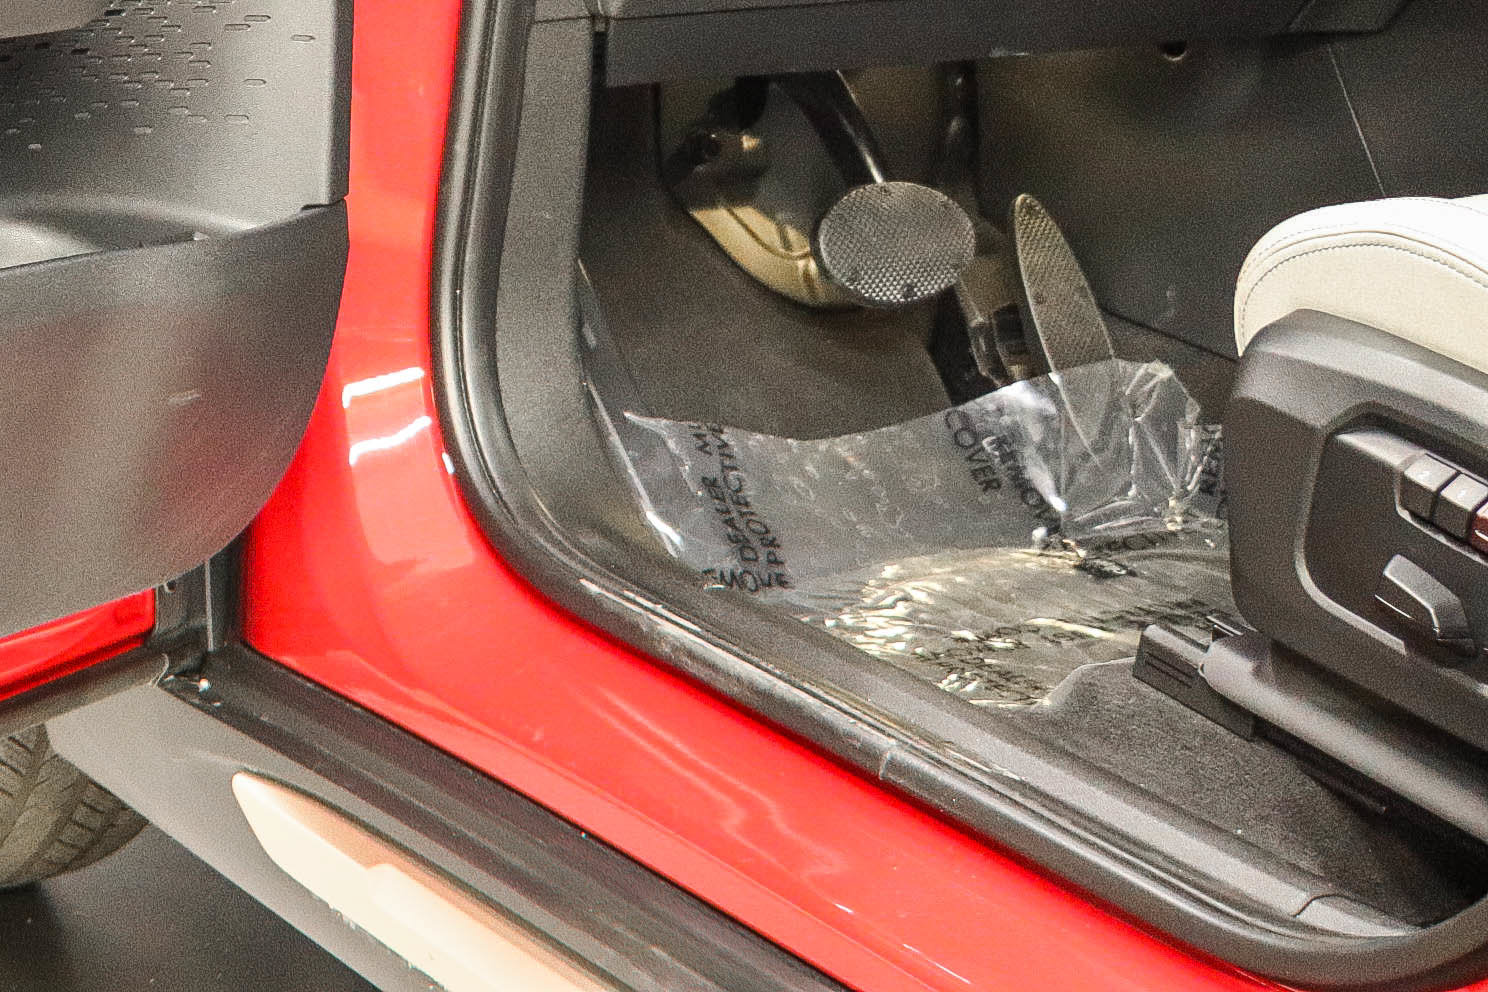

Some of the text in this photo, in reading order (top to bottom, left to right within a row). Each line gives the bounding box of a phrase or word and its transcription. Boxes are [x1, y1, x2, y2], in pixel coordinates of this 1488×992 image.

[710, 425, 785, 565] PROTECTIVE
[944, 410, 1002, 493] COVER
[701, 475, 759, 563] DEALER
